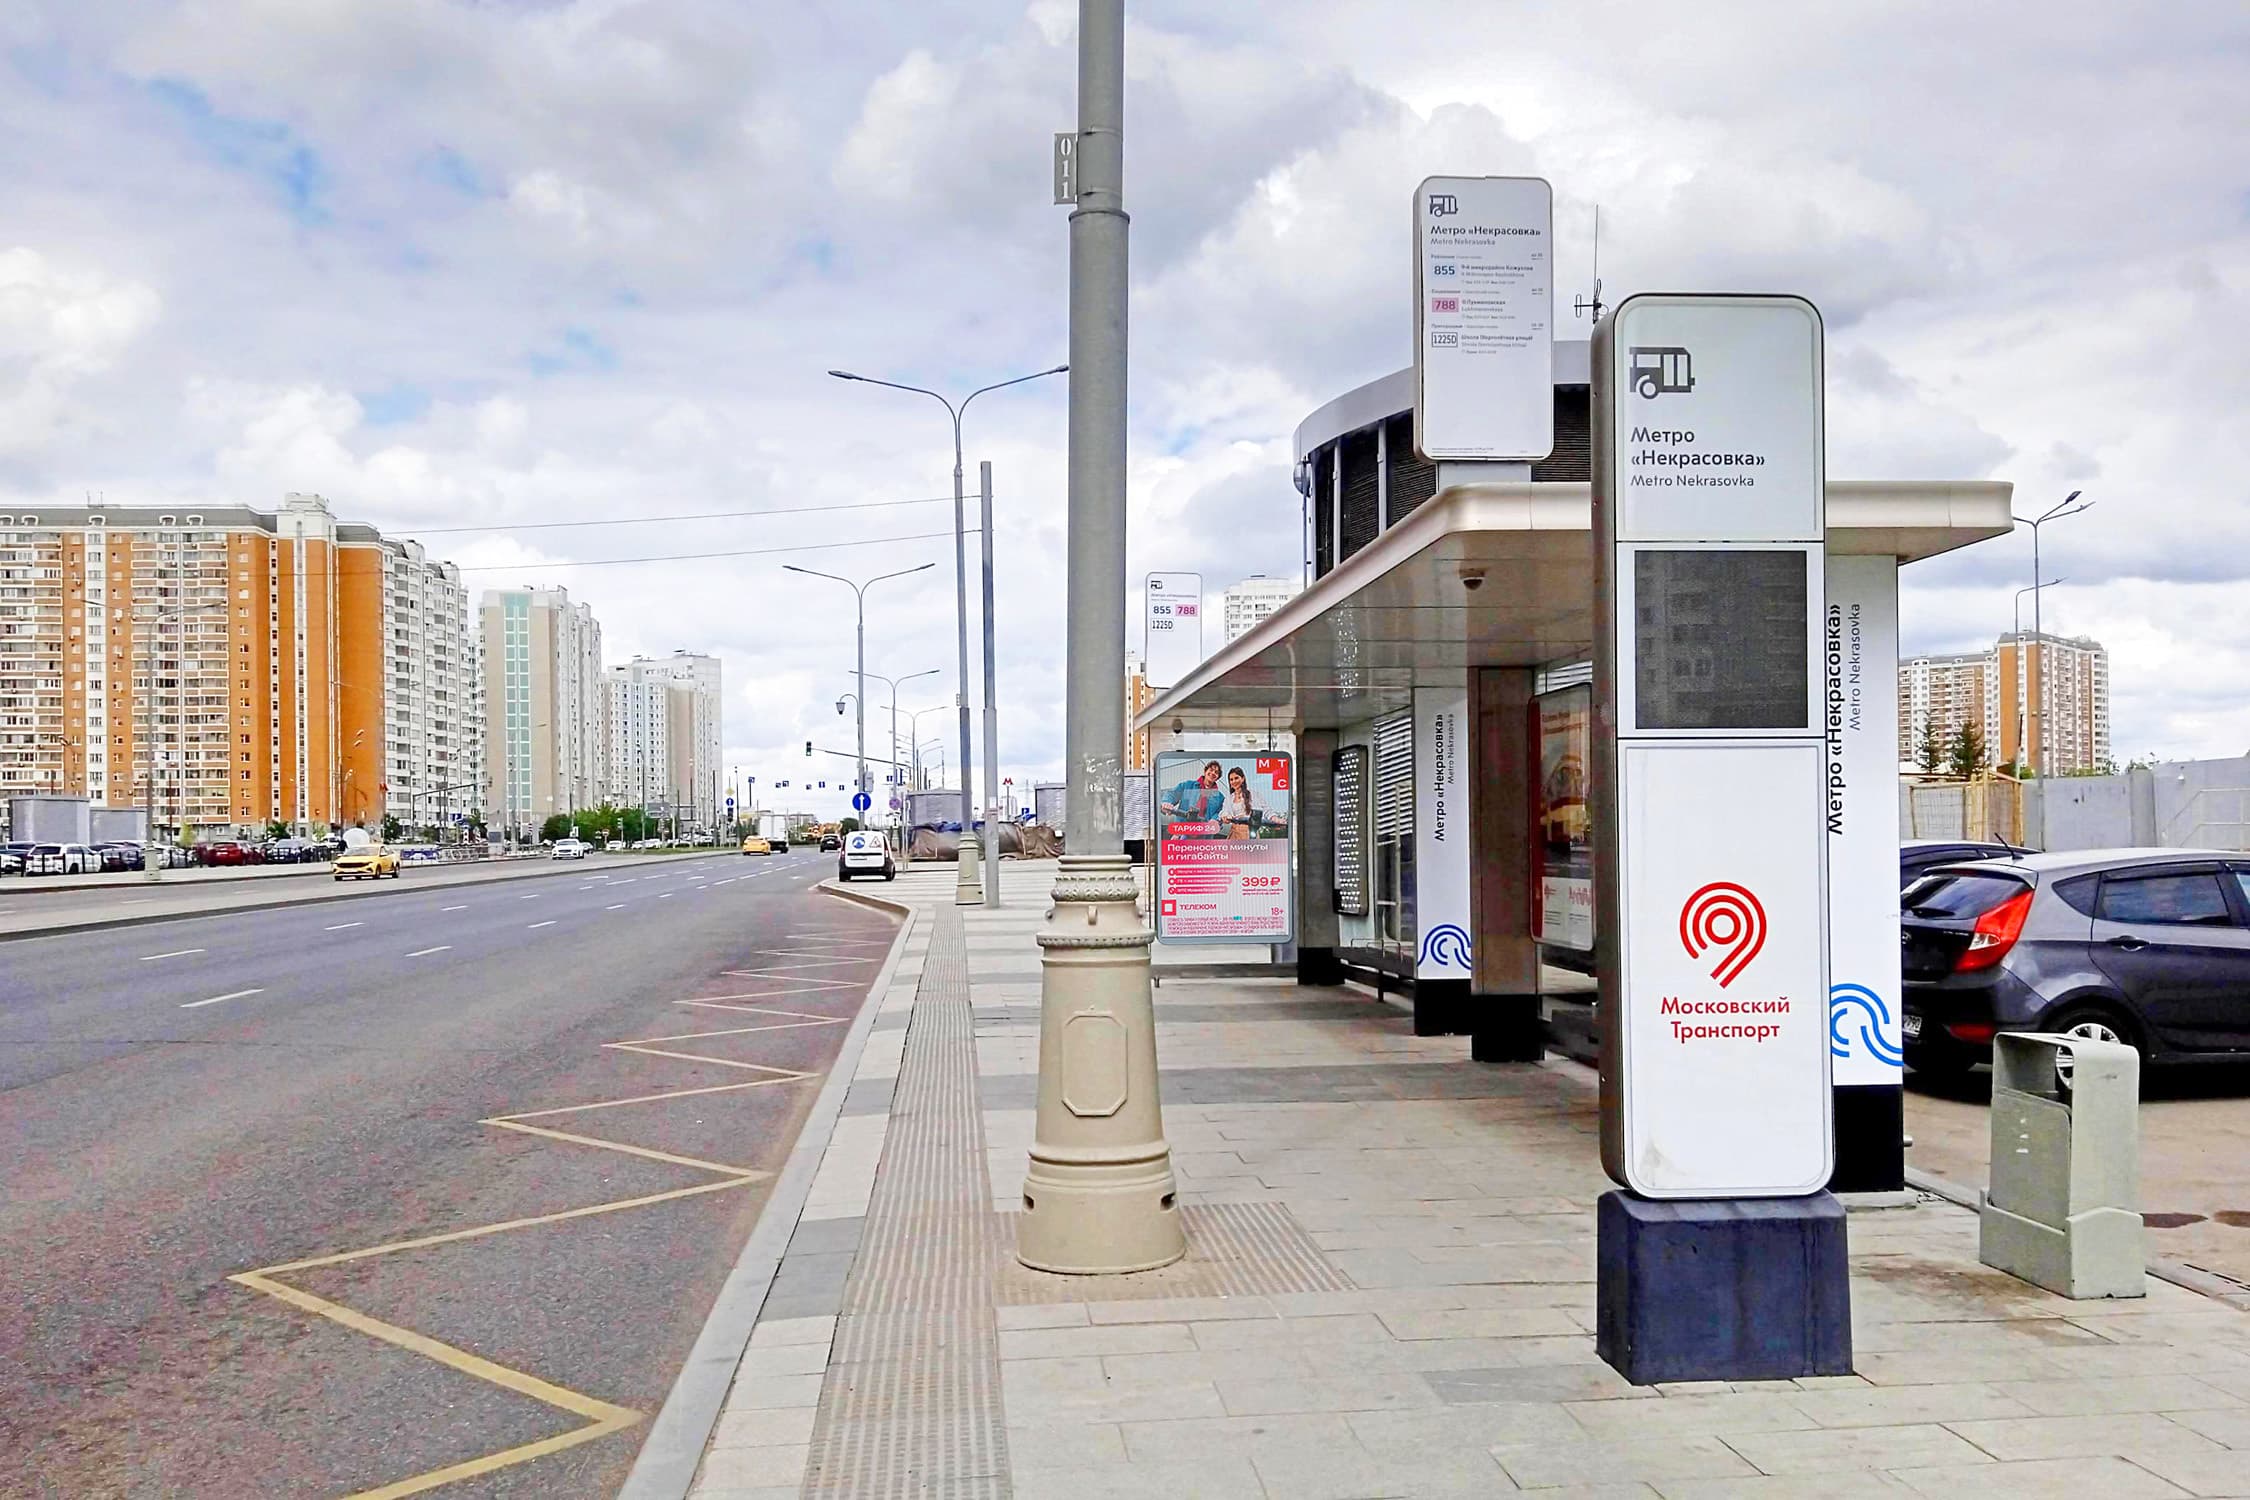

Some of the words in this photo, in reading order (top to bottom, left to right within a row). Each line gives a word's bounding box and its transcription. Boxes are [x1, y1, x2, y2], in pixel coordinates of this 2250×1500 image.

[1060, 137, 1072, 200] 011
[1430, 225, 1466, 237] Метро
[1468, 225, 1541, 237] «Некрасовка»
[1434, 265, 1456, 276] 855
[1434, 300, 1456, 311] 788
[1630, 426, 1695, 446] Метро
[1631, 449, 1765, 469] «Некрасовка»
[1630, 475, 1673, 487] Metro
[1676, 475, 1755, 487] Nekrasovka
[1153, 605, 1172, 615] 855
[1177, 606, 1196, 615] 788
[1848, 603, 1861, 685] Nekrasovka
[1827, 603, 1846, 756] «Некрасовка»
[1849, 687, 1861, 731] Metro
[1434, 714, 1446, 798] «Некрасовка»
[1447, 760, 1455, 784] Metro
[1827, 762, 1846, 836] Метро
[1173, 824, 1204, 832] ТАРИФ
[1204, 824, 1216, 832] 24
[1434, 800, 1447, 842] Метро
[1167, 843, 1229, 853] Переносите
[1229, 844, 1269, 853] минуты
[1167, 853, 1175, 861] и
[1175, 851, 1229, 861] гигабайты
[1241, 876, 1269, 887] 399
[1271, 907, 1284, 916] 18+
[1660, 996, 1791, 1015] Московский
[1670, 1021, 1781, 1045] Транспорт
